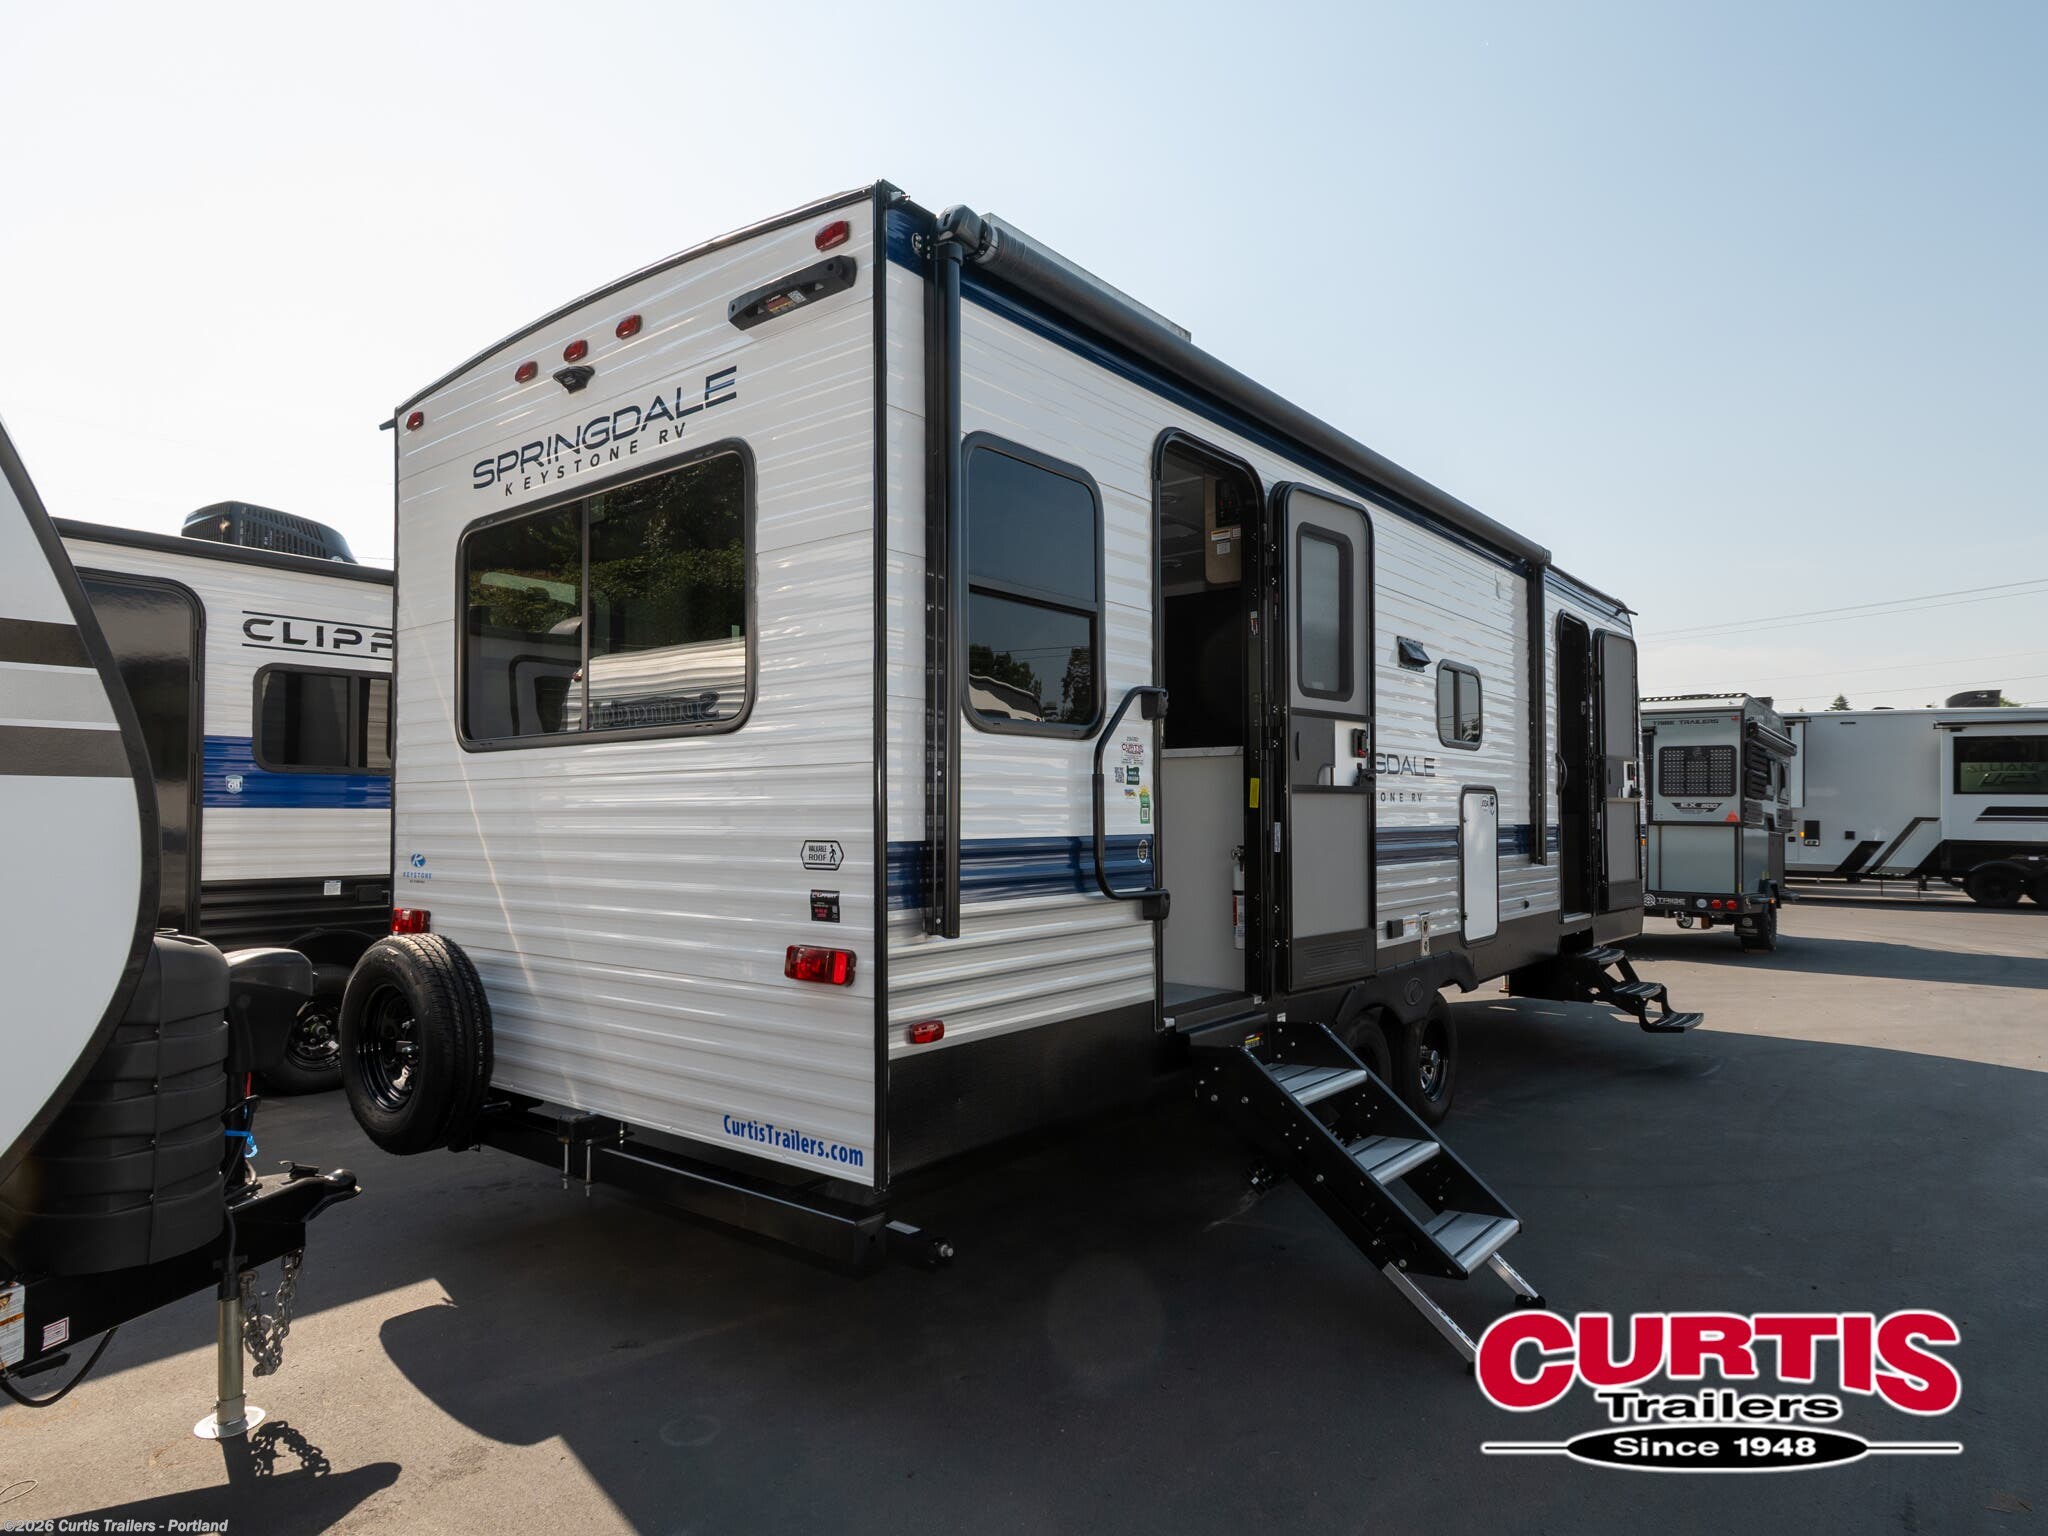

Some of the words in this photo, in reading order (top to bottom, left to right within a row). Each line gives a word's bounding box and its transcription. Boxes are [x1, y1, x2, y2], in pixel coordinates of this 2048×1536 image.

[473, 366, 737, 489] SPRINGDALE
[505, 440, 638, 496] KEYSTONE
[658, 422, 686, 444] RV
[1411, 793, 1422, 802] RV
[808, 853, 827, 861] ROOF
[403, 871, 433, 879] KEYSTONE
[1656, 897, 1686, 905] TRIBE
[723, 1115, 864, 1167] CurtisTrailers.com
